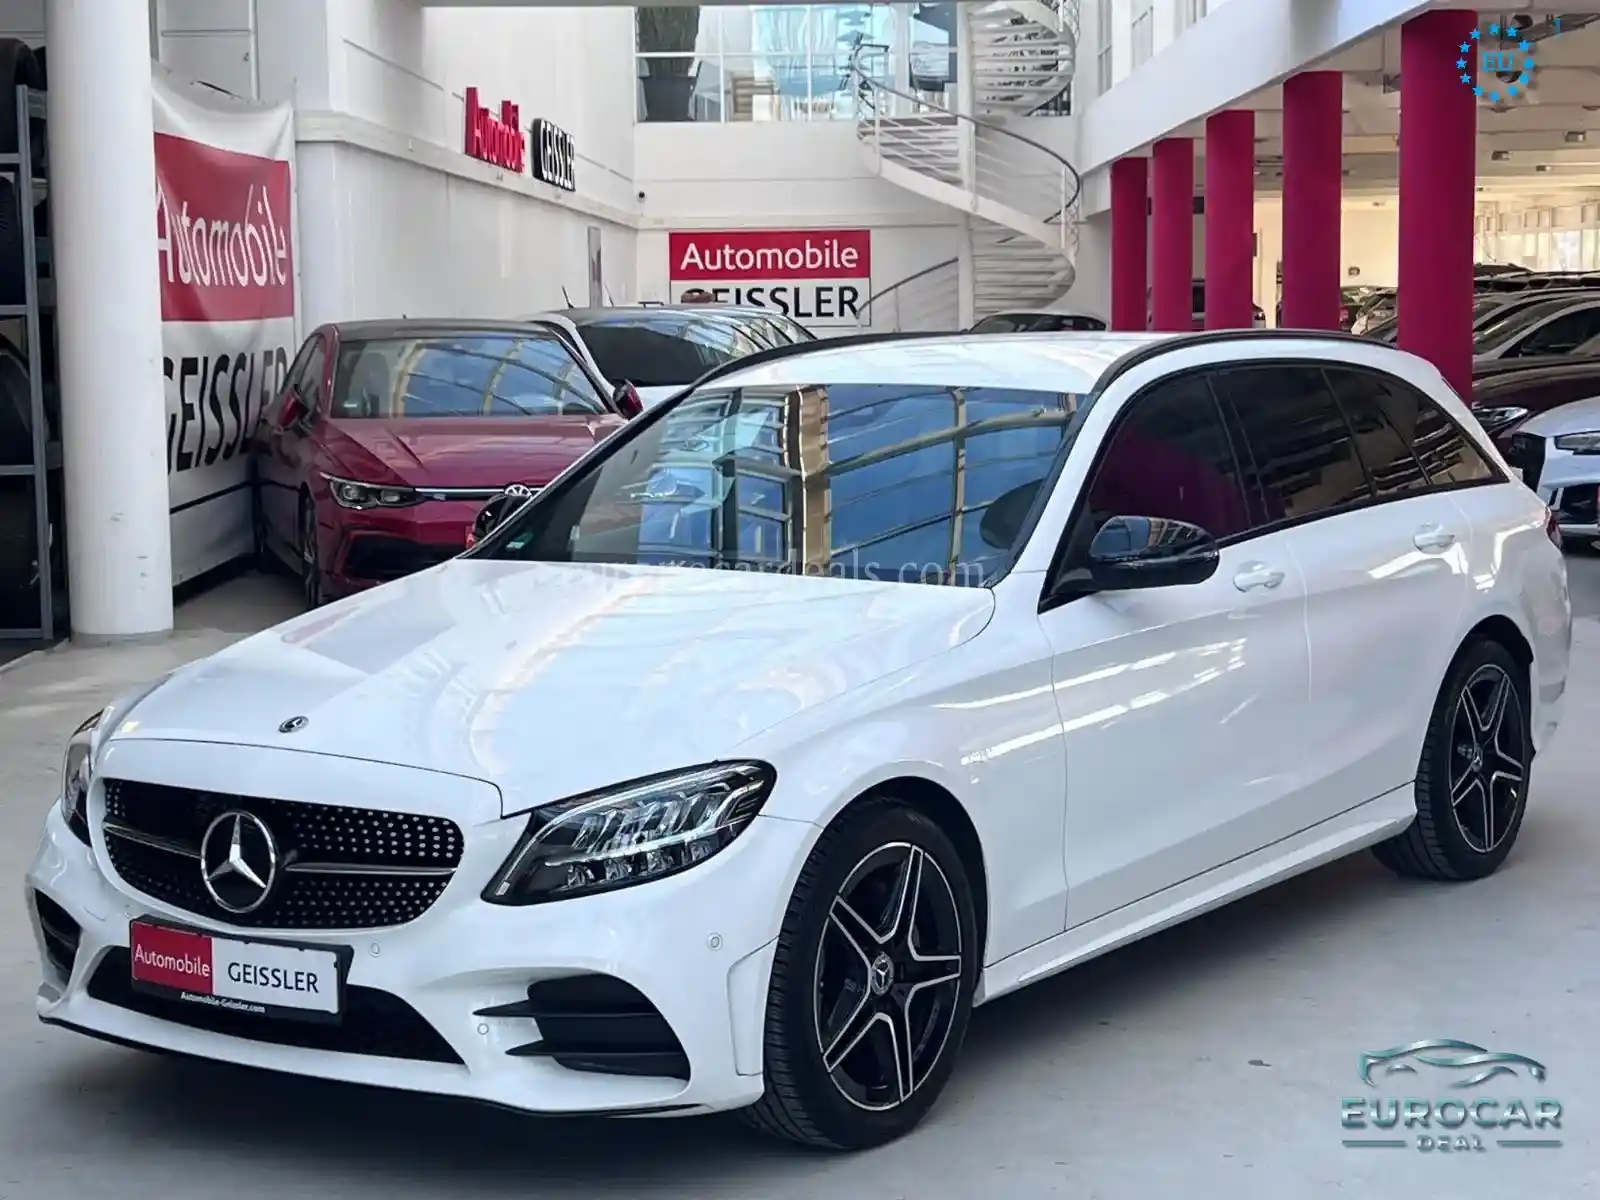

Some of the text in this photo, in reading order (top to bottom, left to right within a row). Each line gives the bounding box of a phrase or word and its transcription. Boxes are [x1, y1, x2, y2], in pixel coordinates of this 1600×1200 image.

[533, 118, 576, 191] GEISSLER
[680, 239, 859, 271] Automobile
[134, 943, 319, 993] Automobile GEISSLER
